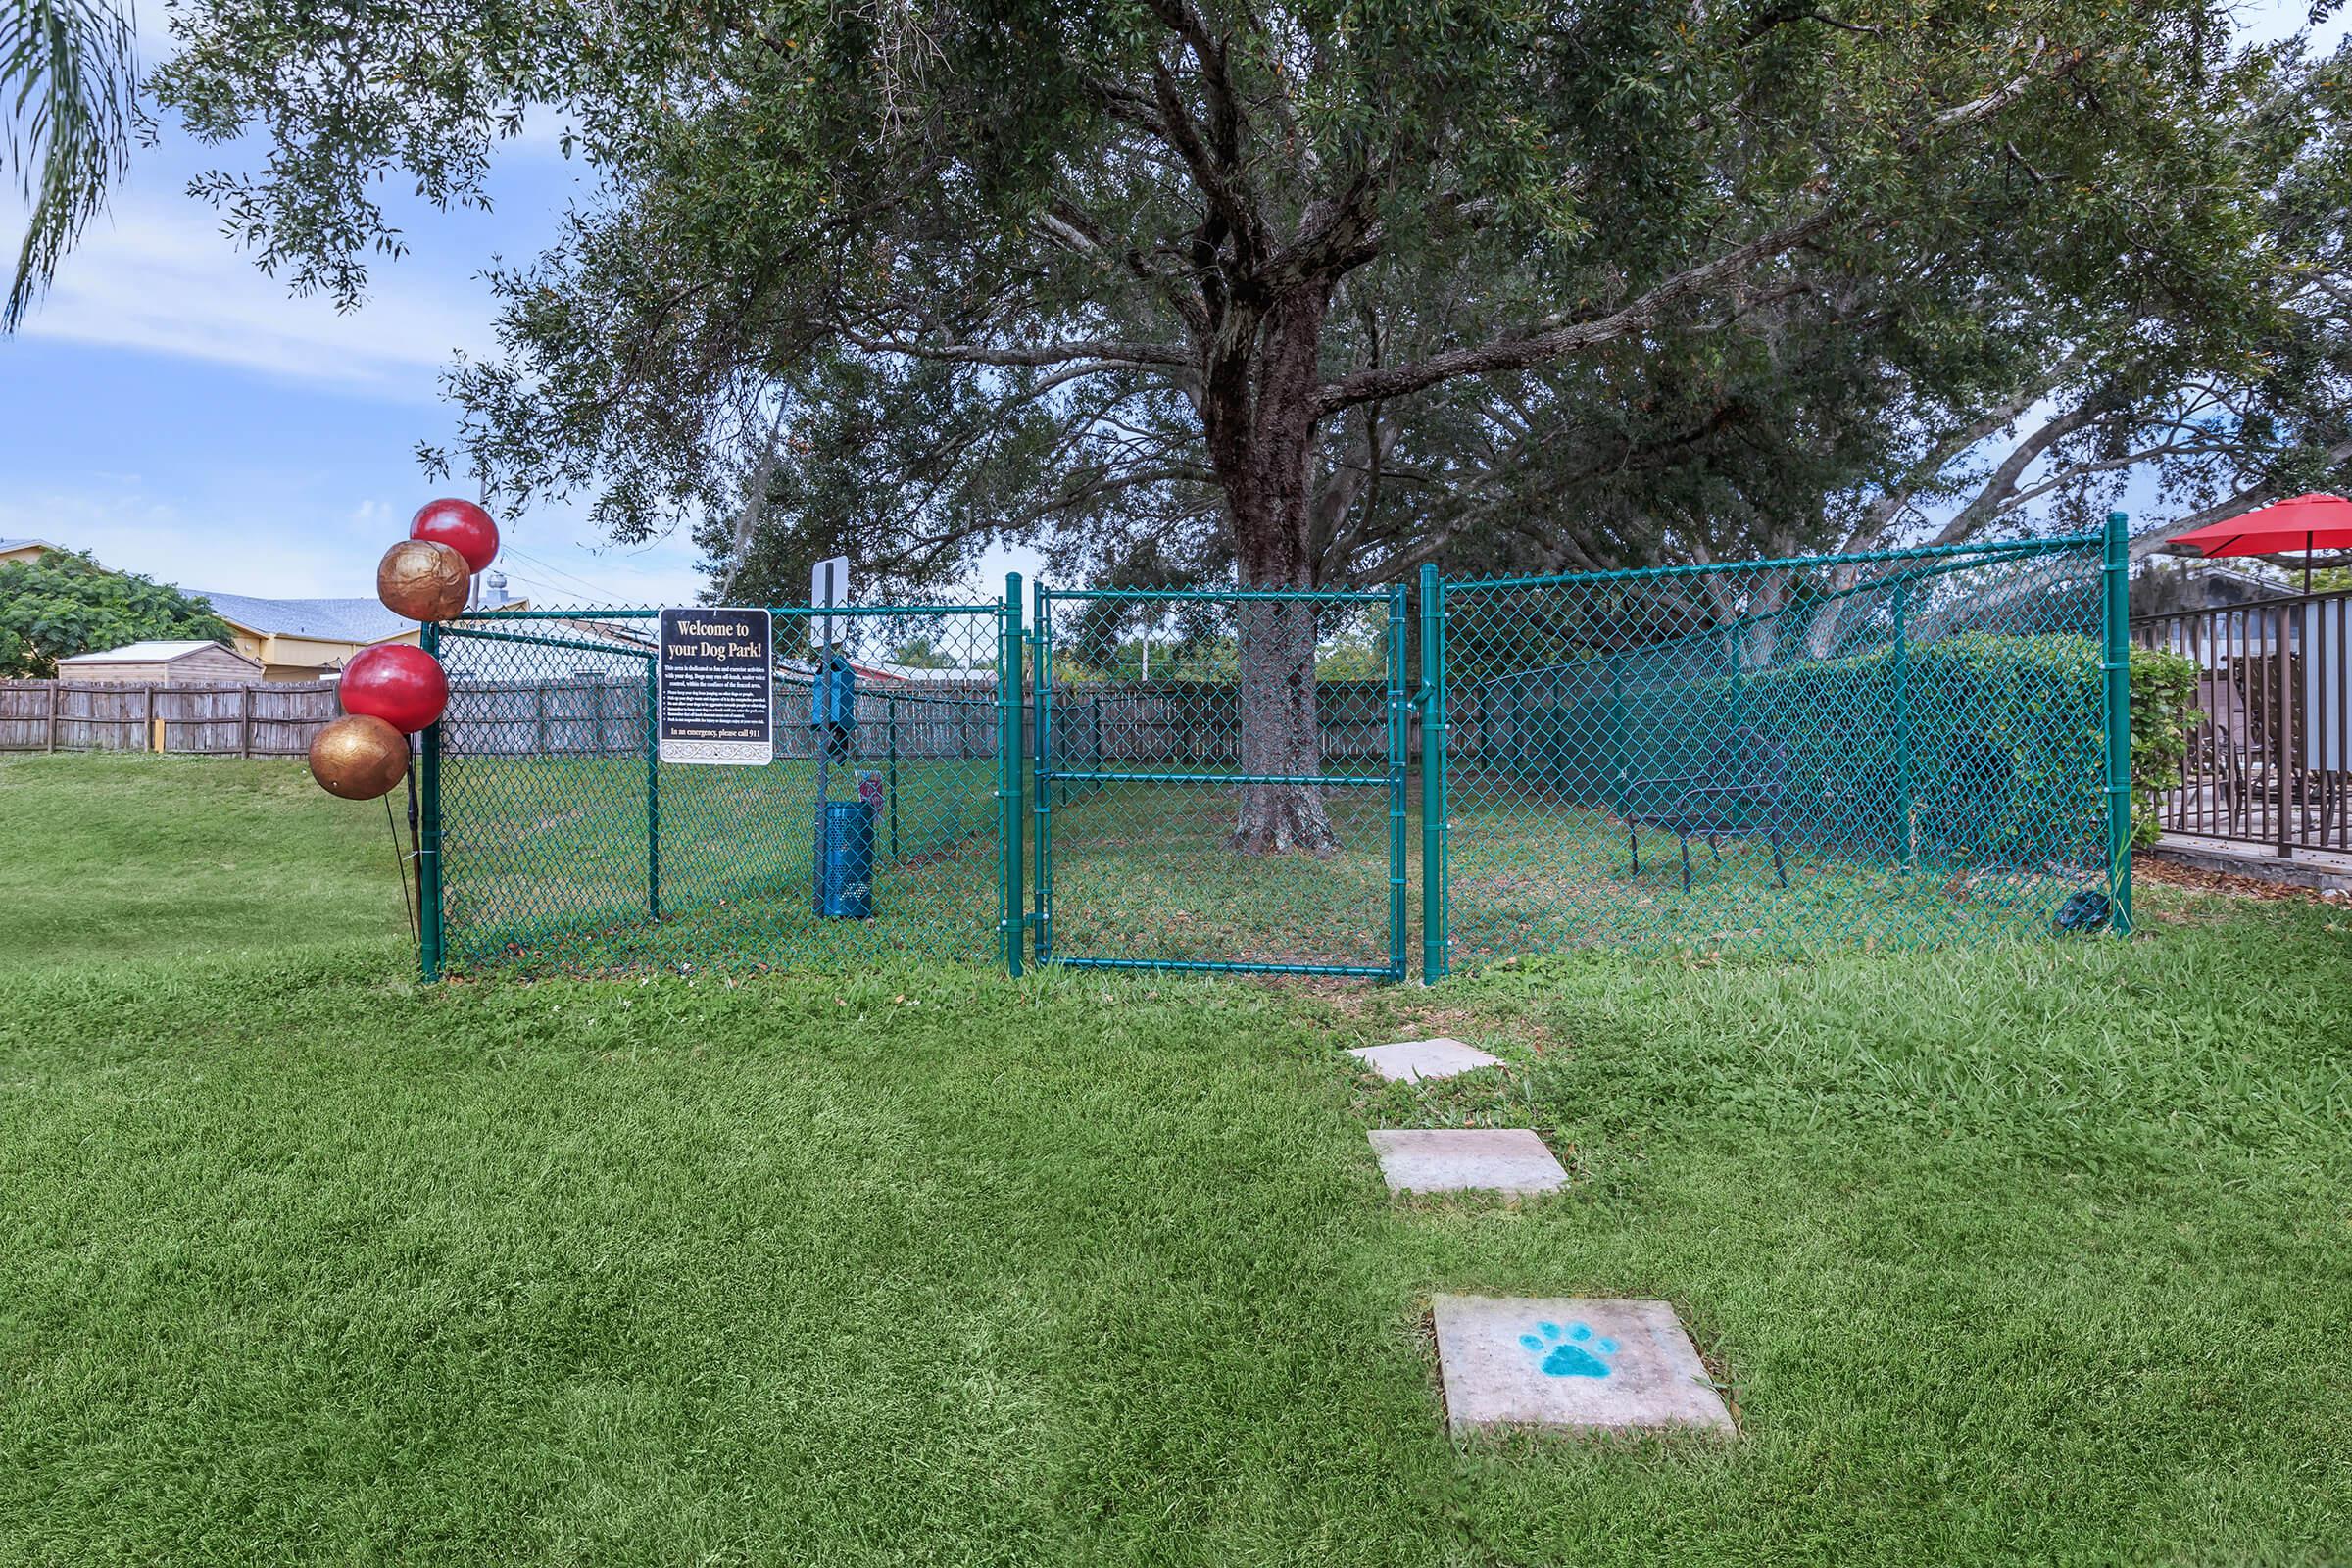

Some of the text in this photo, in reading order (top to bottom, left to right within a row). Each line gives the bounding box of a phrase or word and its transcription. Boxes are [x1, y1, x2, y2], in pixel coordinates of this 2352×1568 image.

[678, 620, 749, 636] Welcome to
[668, 642, 761, 661] your Dog Park!
[719, 728, 737, 738] please
